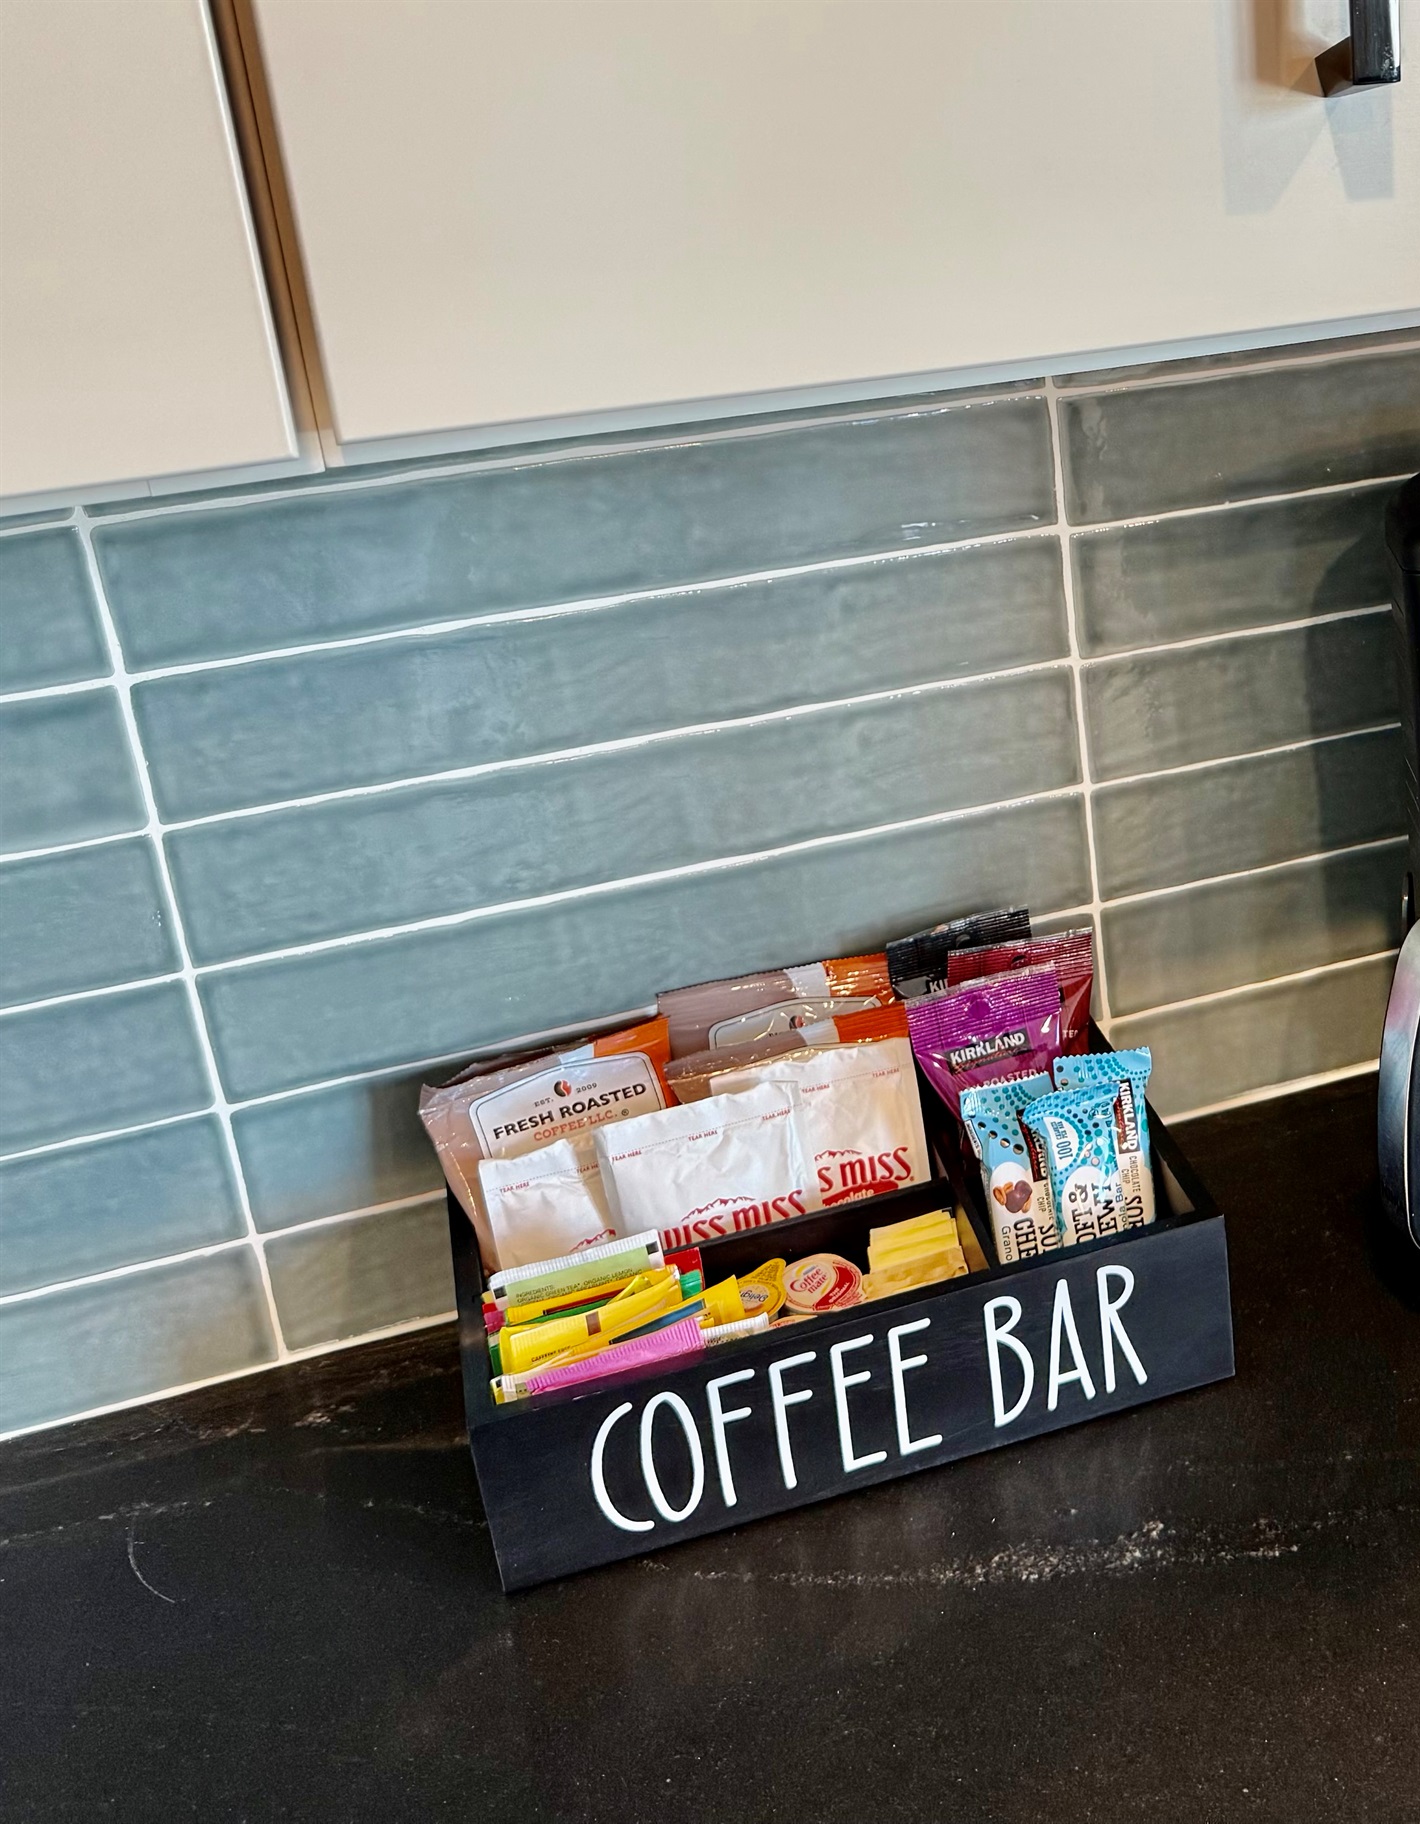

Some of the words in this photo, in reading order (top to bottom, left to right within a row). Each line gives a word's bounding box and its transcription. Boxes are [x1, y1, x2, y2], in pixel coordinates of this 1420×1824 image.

[950, 1032, 1025, 1065] KIRKLAND
[872, 1070, 886, 1079] TEAR
[534, 1097, 554, 1108] EST.
[575, 1082, 598, 1094] 2009
[492, 1109, 555, 1140] FRESH
[559, 1082, 647, 1119] ROASTED
[1119, 1081, 1137, 1151] KIRKLAND
[533, 1117, 585, 1142] COFFEE
[589, 1109, 618, 1126] LLC.
[688, 1132, 702, 1142] TEAR
[703, 1129, 718, 1138] HERE
[611, 1153, 627, 1164] TEAR
[627, 1150, 642, 1159] HERE
[1056, 1139, 1074, 1160] 100
[840, 1146, 911, 1188] MISS
[1121, 1168, 1130, 1185] CHIP
[1128, 1155, 1142, 1193] CHOCOLATE
[499, 1185, 514, 1194] TEAR
[515, 1181, 530, 1190] HERE
[1036, 1196, 1047, 1213] CHIP
[1001, 1225, 1013, 1261] Grano
[1013, 1217, 1039, 1259] CHE
[790, 1268, 822, 1293] Coffee
[807, 1273, 827, 1294] mate
[591, 1317, 943, 1532] COFFEE
[983, 1264, 1148, 1428] BAR
